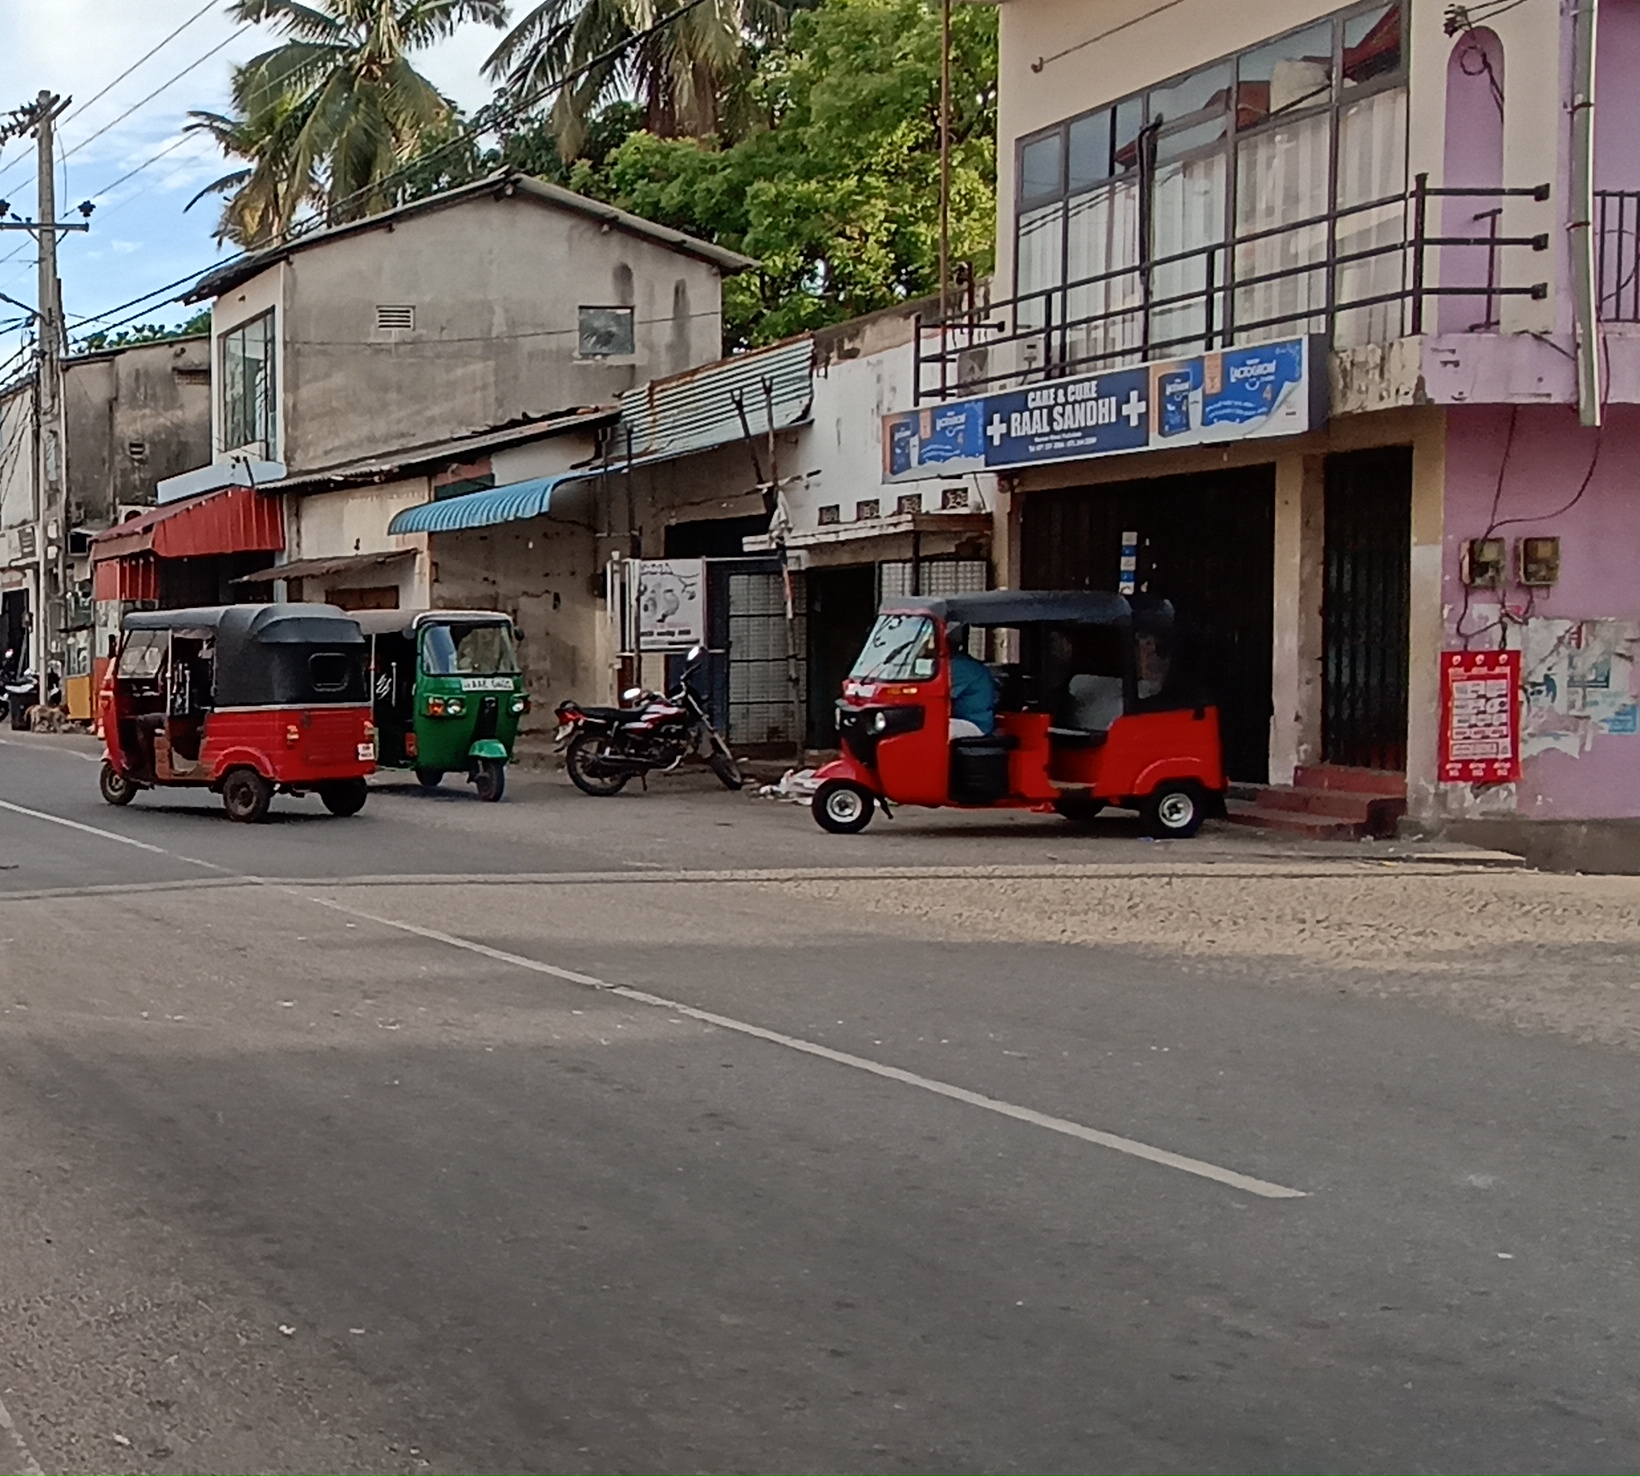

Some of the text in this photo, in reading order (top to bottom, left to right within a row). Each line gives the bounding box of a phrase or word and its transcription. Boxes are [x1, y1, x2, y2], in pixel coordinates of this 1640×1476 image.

[1027, 381, 1098, 409] CARE & CURE
[1010, 408, 1050, 438] RAAL
[1052, 397, 1117, 430] SANDHI
